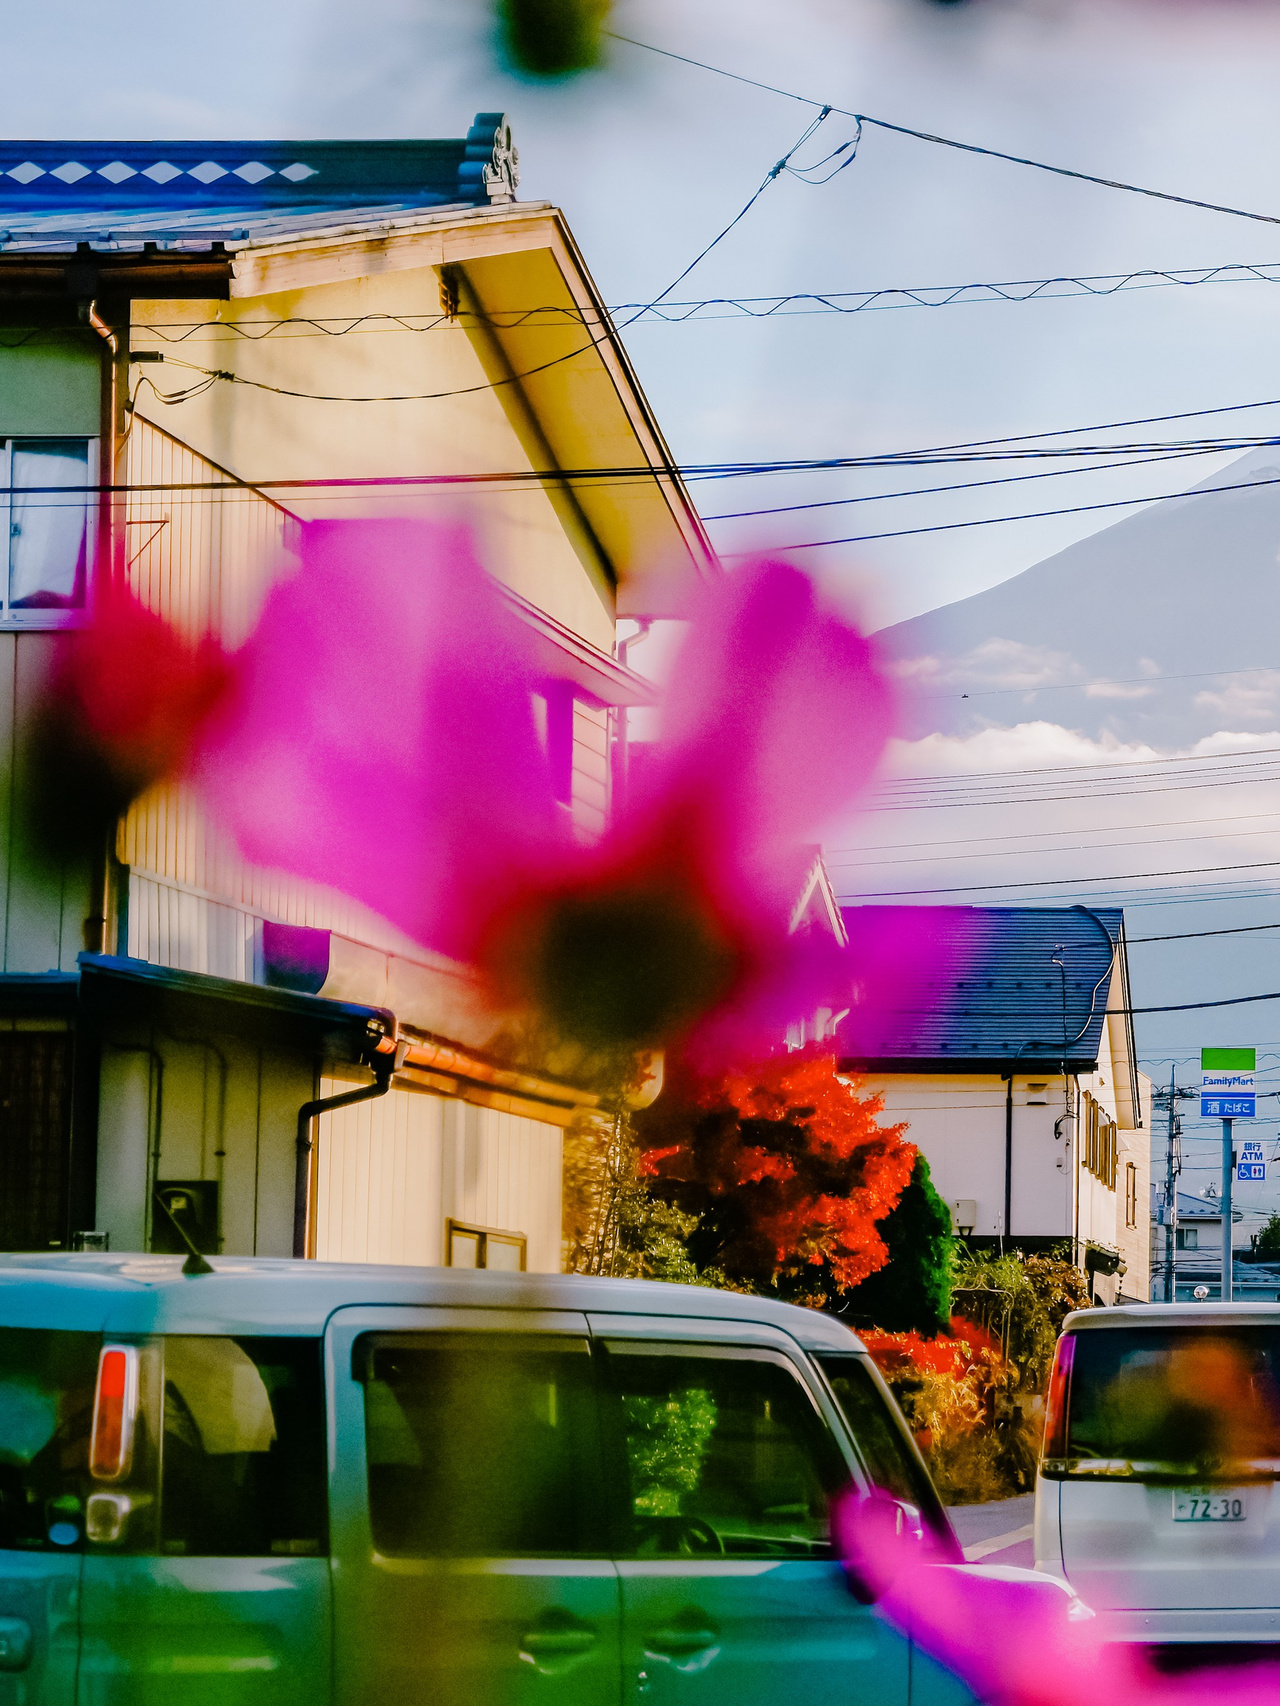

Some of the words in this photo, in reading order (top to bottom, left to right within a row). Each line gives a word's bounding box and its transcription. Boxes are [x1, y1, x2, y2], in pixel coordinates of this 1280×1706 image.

[1203, 1076, 1254, 1087] FamilyMart
[1207, 1101, 1220, 1114] 酒
[1224, 1102, 1251, 1113] たばこ
[1243, 1142, 1262, 1152] 銀行
[1241, 1152, 1263, 1161] ATM
[1190, 1499, 1242, 1518] 72-30
